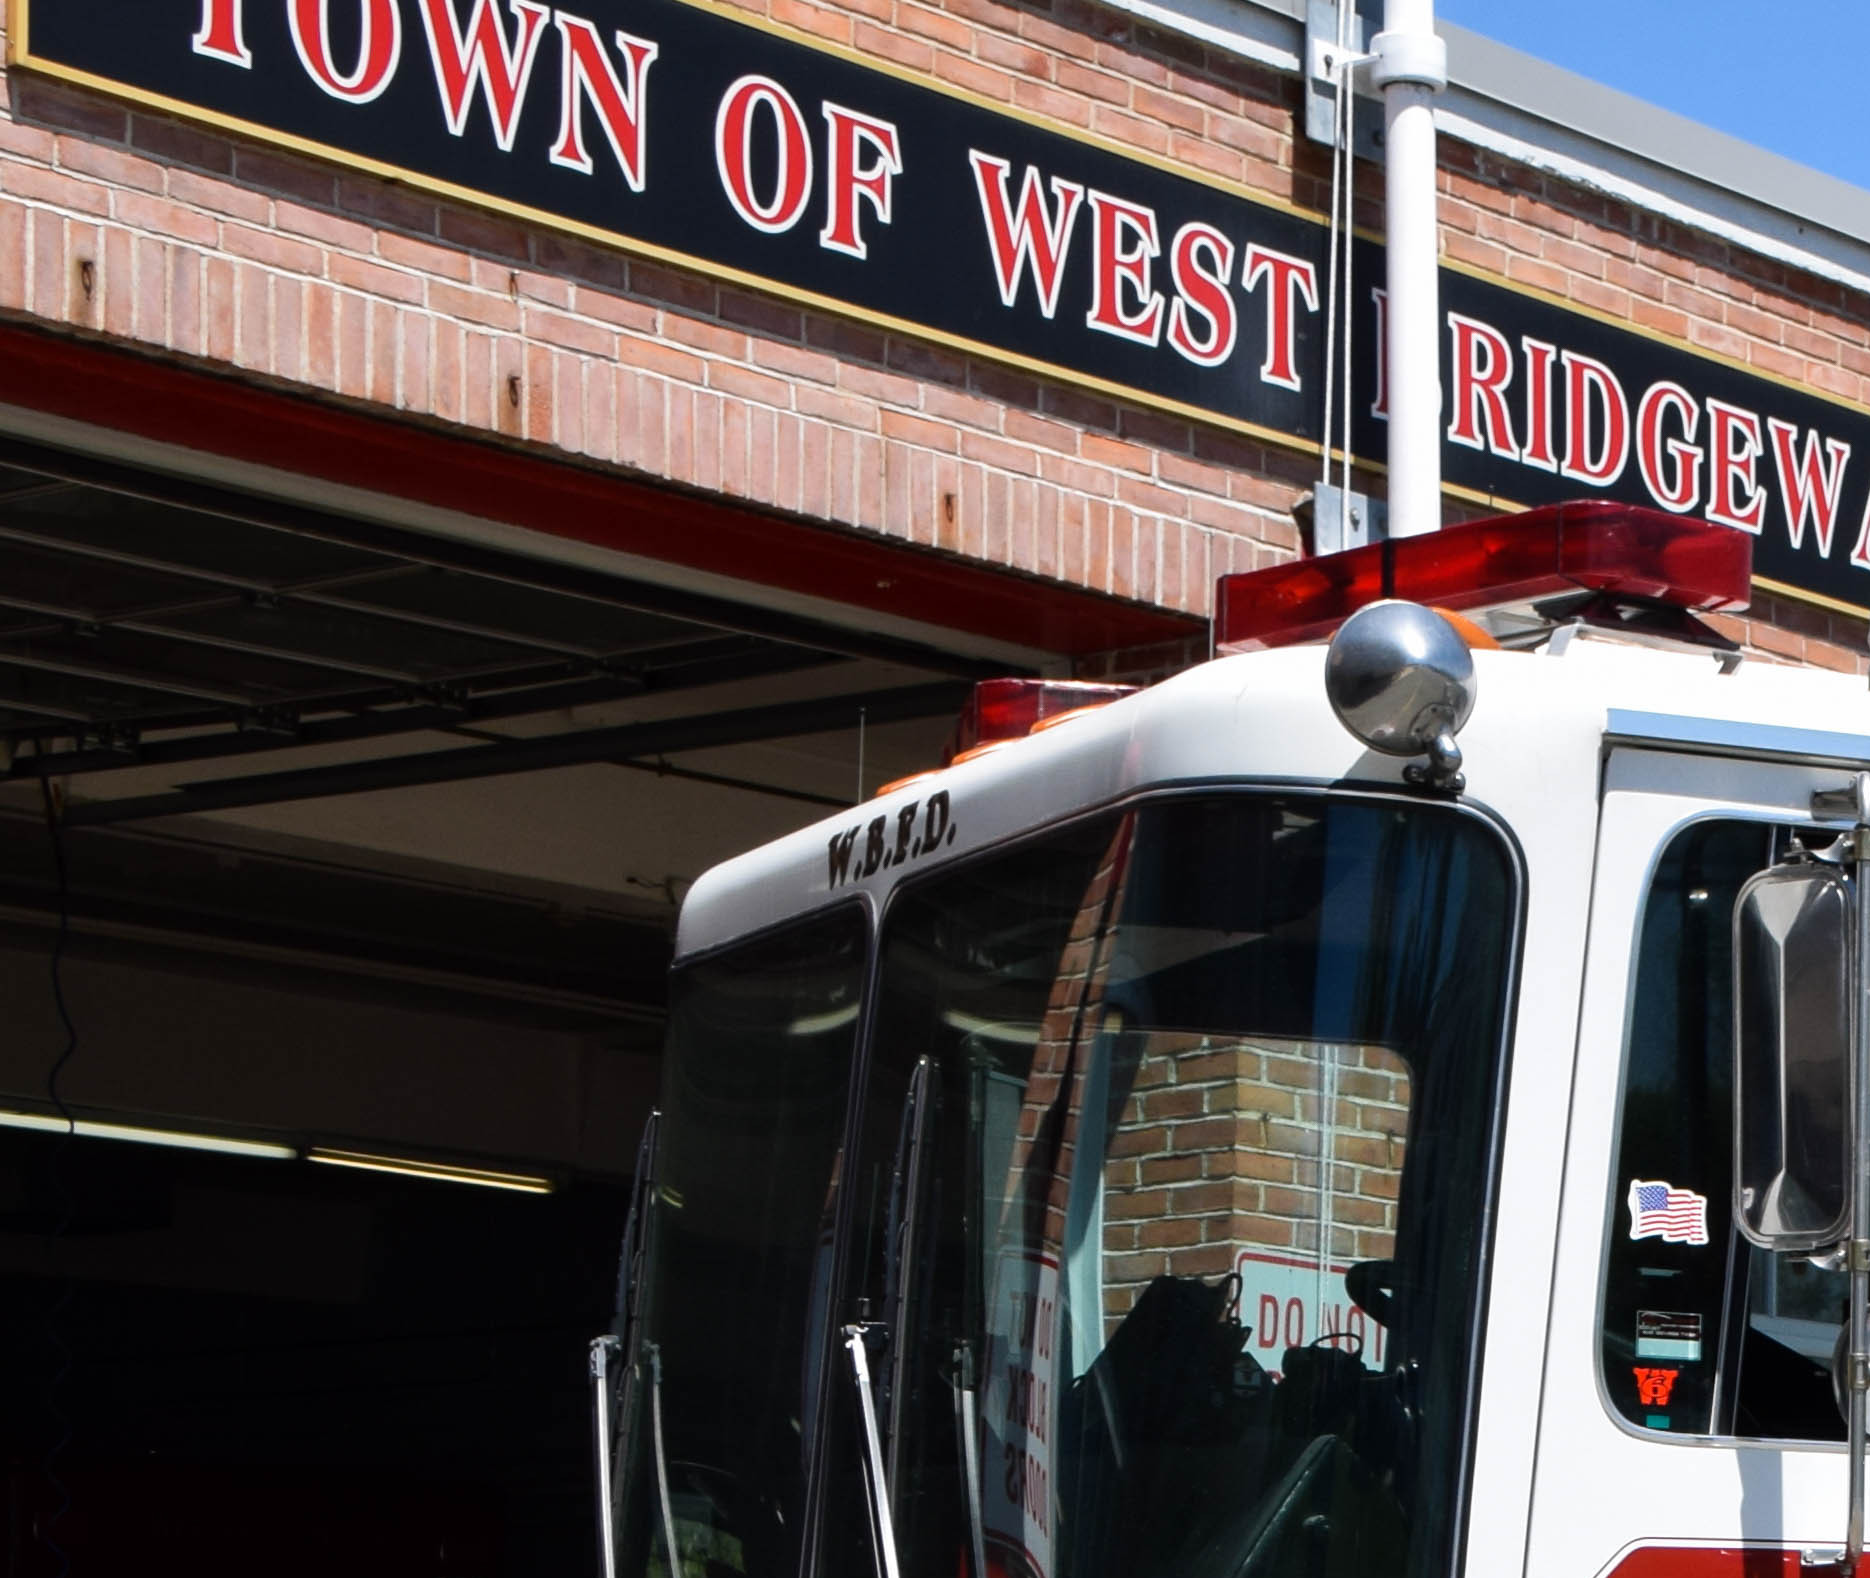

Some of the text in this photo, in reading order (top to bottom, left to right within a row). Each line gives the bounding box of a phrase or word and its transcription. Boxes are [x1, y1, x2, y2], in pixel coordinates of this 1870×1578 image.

[714, 73, 904, 261] OF
[968, 147, 1321, 393] WEST
[1258, 1294, 1304, 1349] DO
